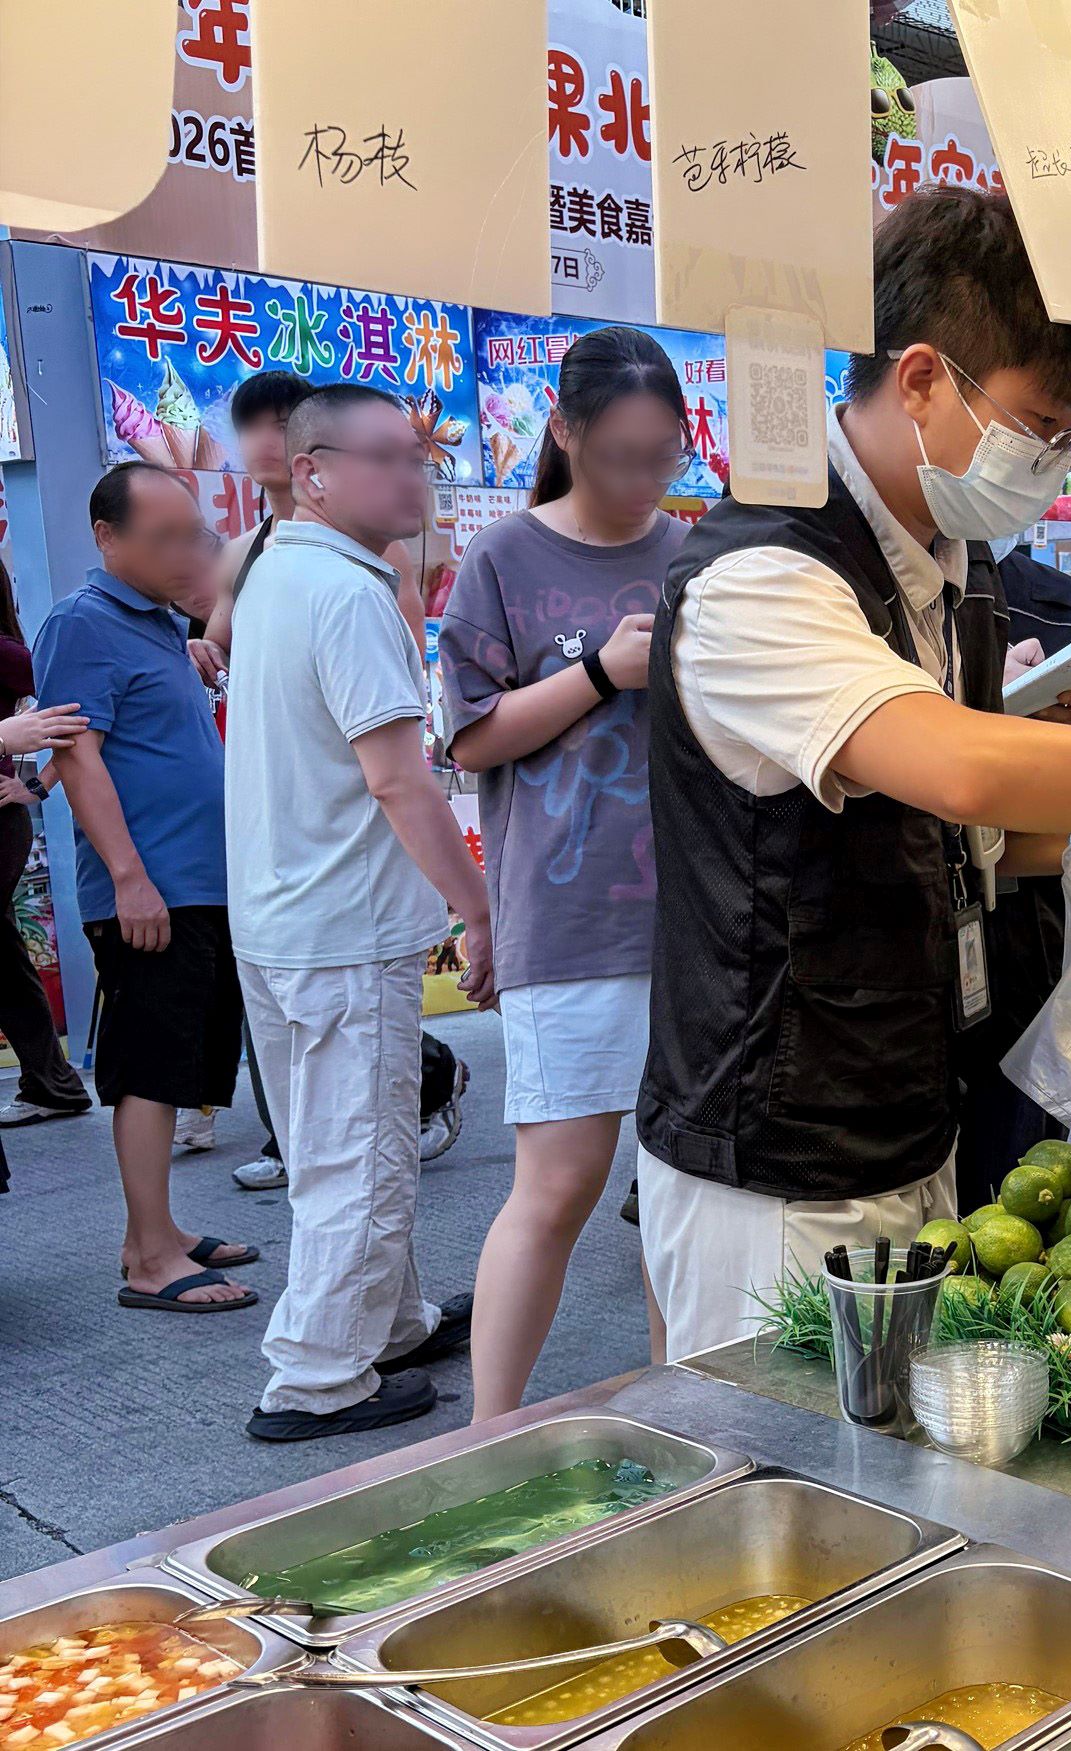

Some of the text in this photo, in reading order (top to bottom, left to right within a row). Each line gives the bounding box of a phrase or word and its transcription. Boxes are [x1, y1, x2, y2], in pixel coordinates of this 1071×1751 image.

[298, 123, 418, 191] 杨枝
[112, 273, 461, 391] 华夫冰淇淋
